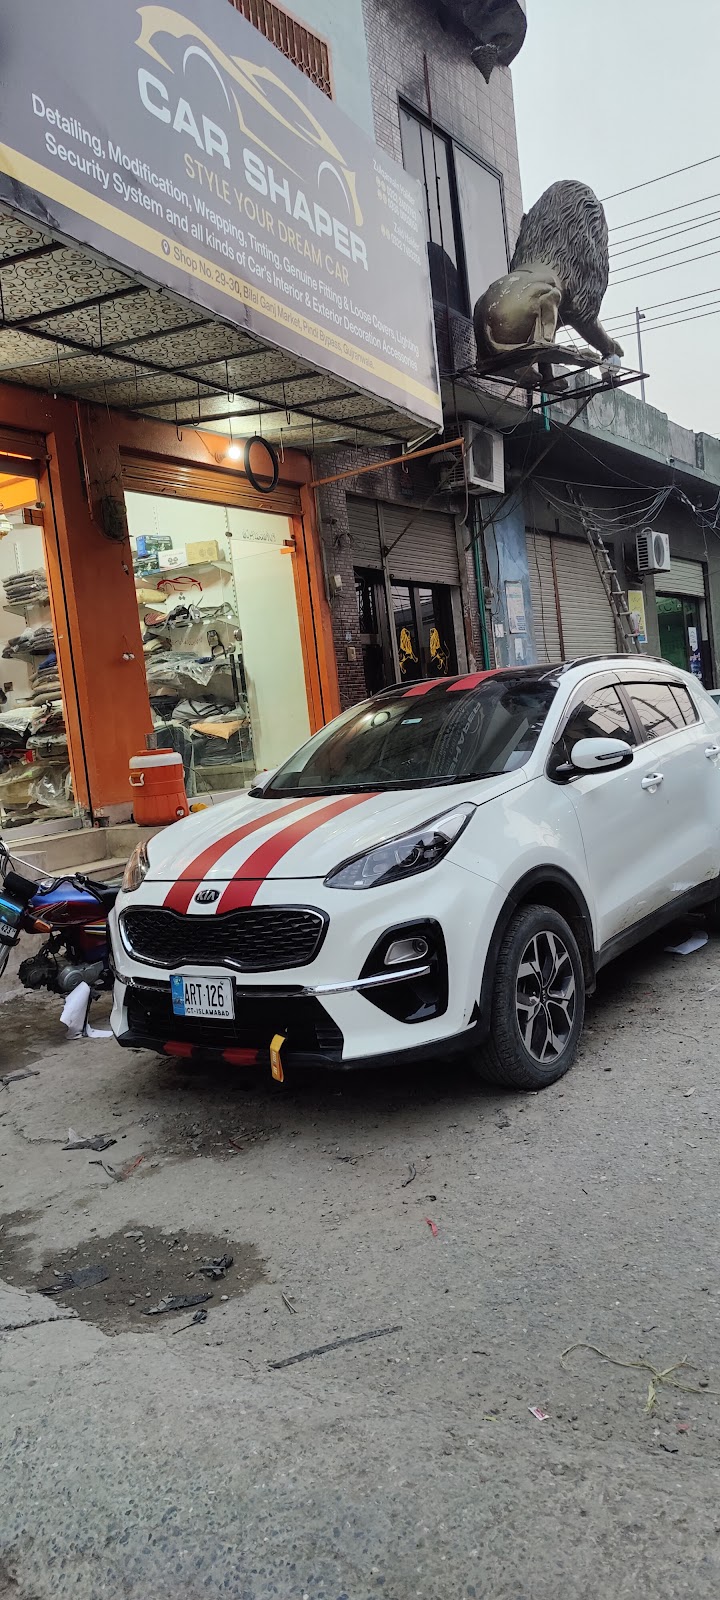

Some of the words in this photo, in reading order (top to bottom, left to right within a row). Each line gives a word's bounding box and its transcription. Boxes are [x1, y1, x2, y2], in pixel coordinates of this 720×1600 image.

[31, 93, 106, 159] Detailing,
[107, 140, 192, 213] Modification,
[192, 194, 247, 248] Wrapping,
[247, 232, 282, 271] Tinting,
[283, 256, 318, 291] Genuine
[318, 280, 343, 310] Fitting
[343, 296, 350, 311] &
[350, 300, 372, 325] Loose
[372, 314, 396, 342] Covers,
[396, 330, 420, 358] Lighting
[44, 131, 109, 189] Security
[112, 172, 164, 219] System
[165, 208, 189, 233] and
[190, 222, 204, 242] all
[205, 227, 235, 260] kinds
[235, 251, 246, 268] of
[247, 256, 272, 284] Car's
[272, 271, 304, 303] Interior
[304, 291, 312, 308] &
[312, 296, 342, 326] Exterior
[343, 315, 382, 350] Decoration
[382, 340, 418, 372] Accessories
[138, 68, 231, 170] CAR
[243, 148, 368, 271] SHAPER
[184, 153, 231, 205] STYLE
[234, 188, 275, 235] YOUR
[278, 219, 322, 269] DREAM
[325, 254, 350, 287] CAR
[173, 245, 198, 272] Shop
[199, 259, 214, 280] No.
[214, 269, 242, 298] 29-30,
[243, 285, 259, 305] Bilal
[260, 296, 277, 318] Ganj
[277, 305, 303, 332] Market,
[302, 319, 319, 339] Pindi
[319, 329, 342, 354] Bypass,
[197, 891, 216, 901] KIA
